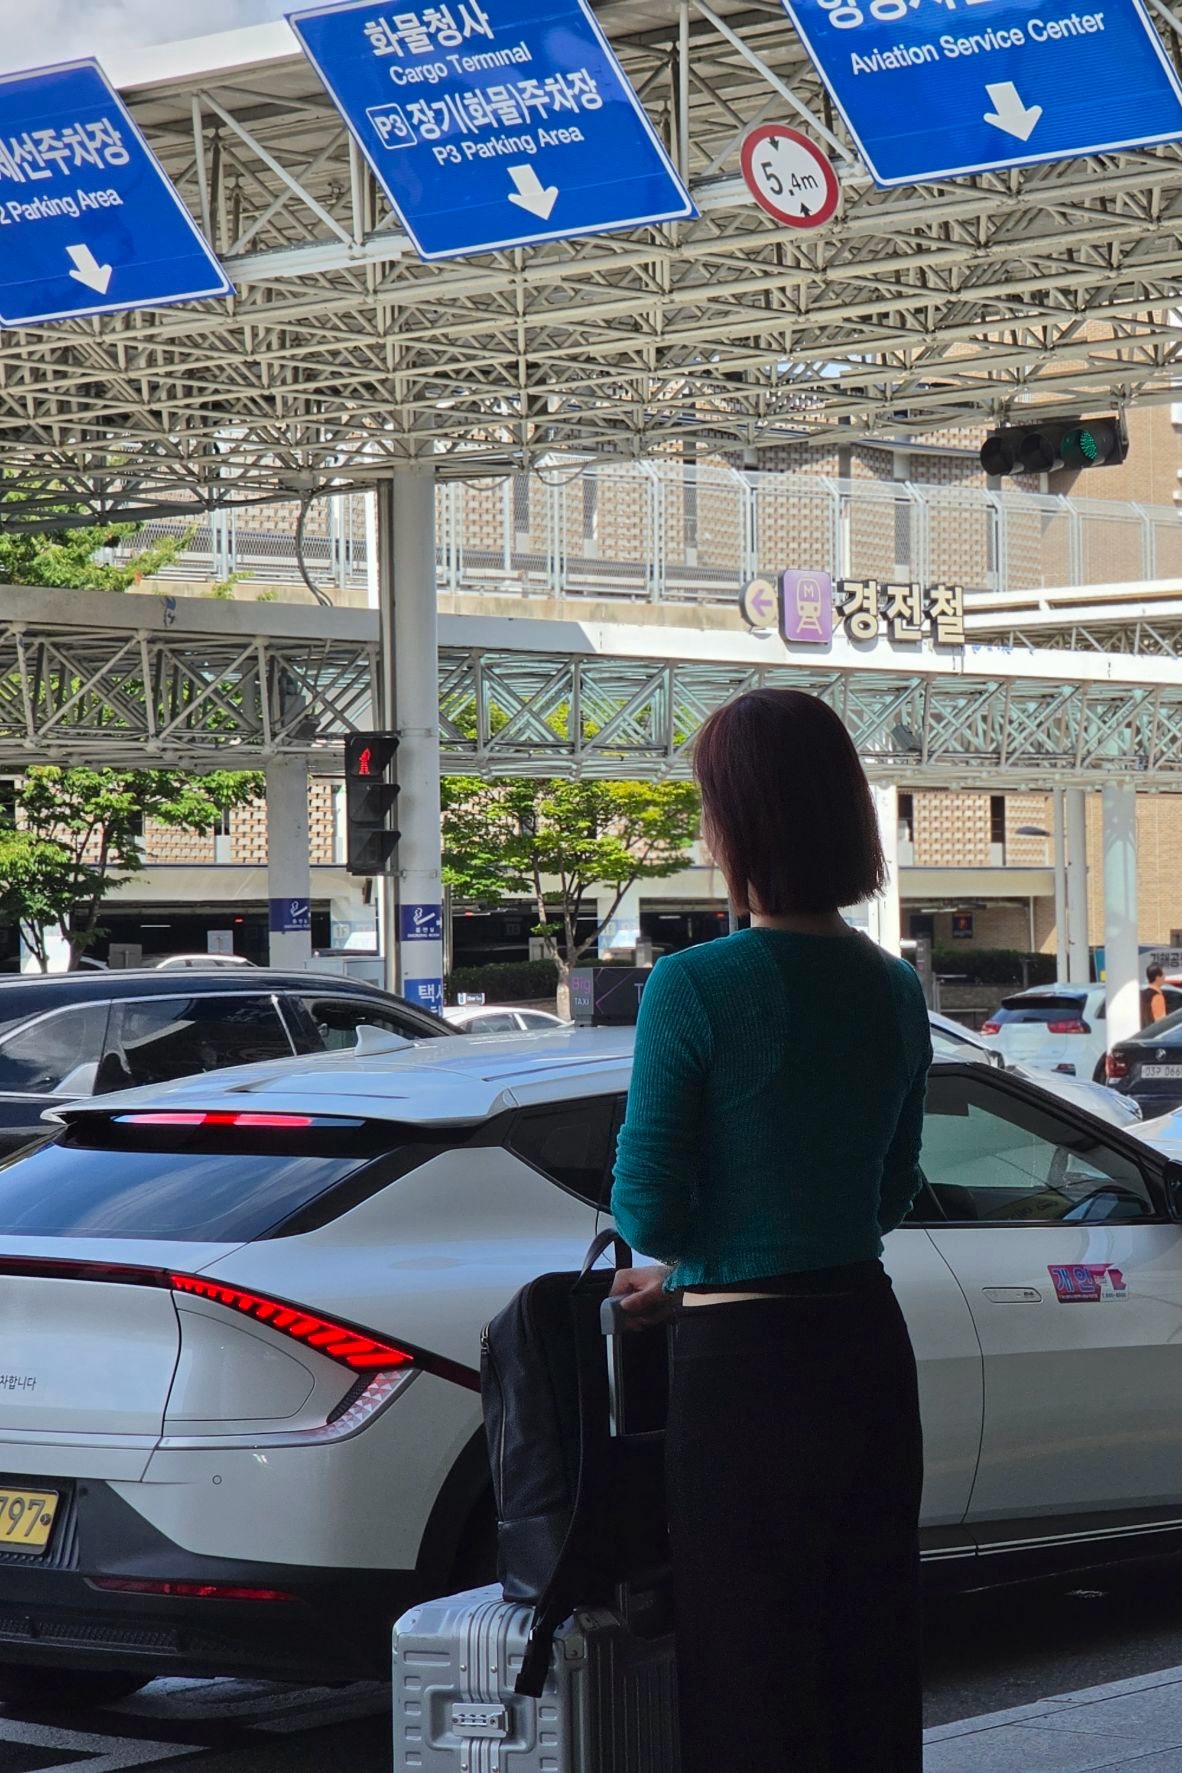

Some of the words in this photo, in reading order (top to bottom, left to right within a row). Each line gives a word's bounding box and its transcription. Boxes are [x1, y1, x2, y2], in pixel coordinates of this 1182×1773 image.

[364, 0, 495, 57] 화물청사
[849, 42, 940, 75] Aviation
[938, 26, 1026, 58] Service
[1026, 9, 1106, 43] Center
[389, 61, 448, 85] Cargo
[446, 41, 533, 74] Terminal
[374, 114, 408, 140] P3
[406, 68, 604, 140] 장기(화물)주차장
[432, 145, 462, 166] P3
[460, 132, 538, 161] Parking
[537, 125, 585, 147] Area
[9, 195, 81, 222] Parking
[77, 188, 124, 210] Area
[840, 579, 966, 644] 경전철
[572, 976, 591, 993] Big
[574, 997, 589, 1006] TAXI
[1051, 1266, 1096, 1293] 개인
